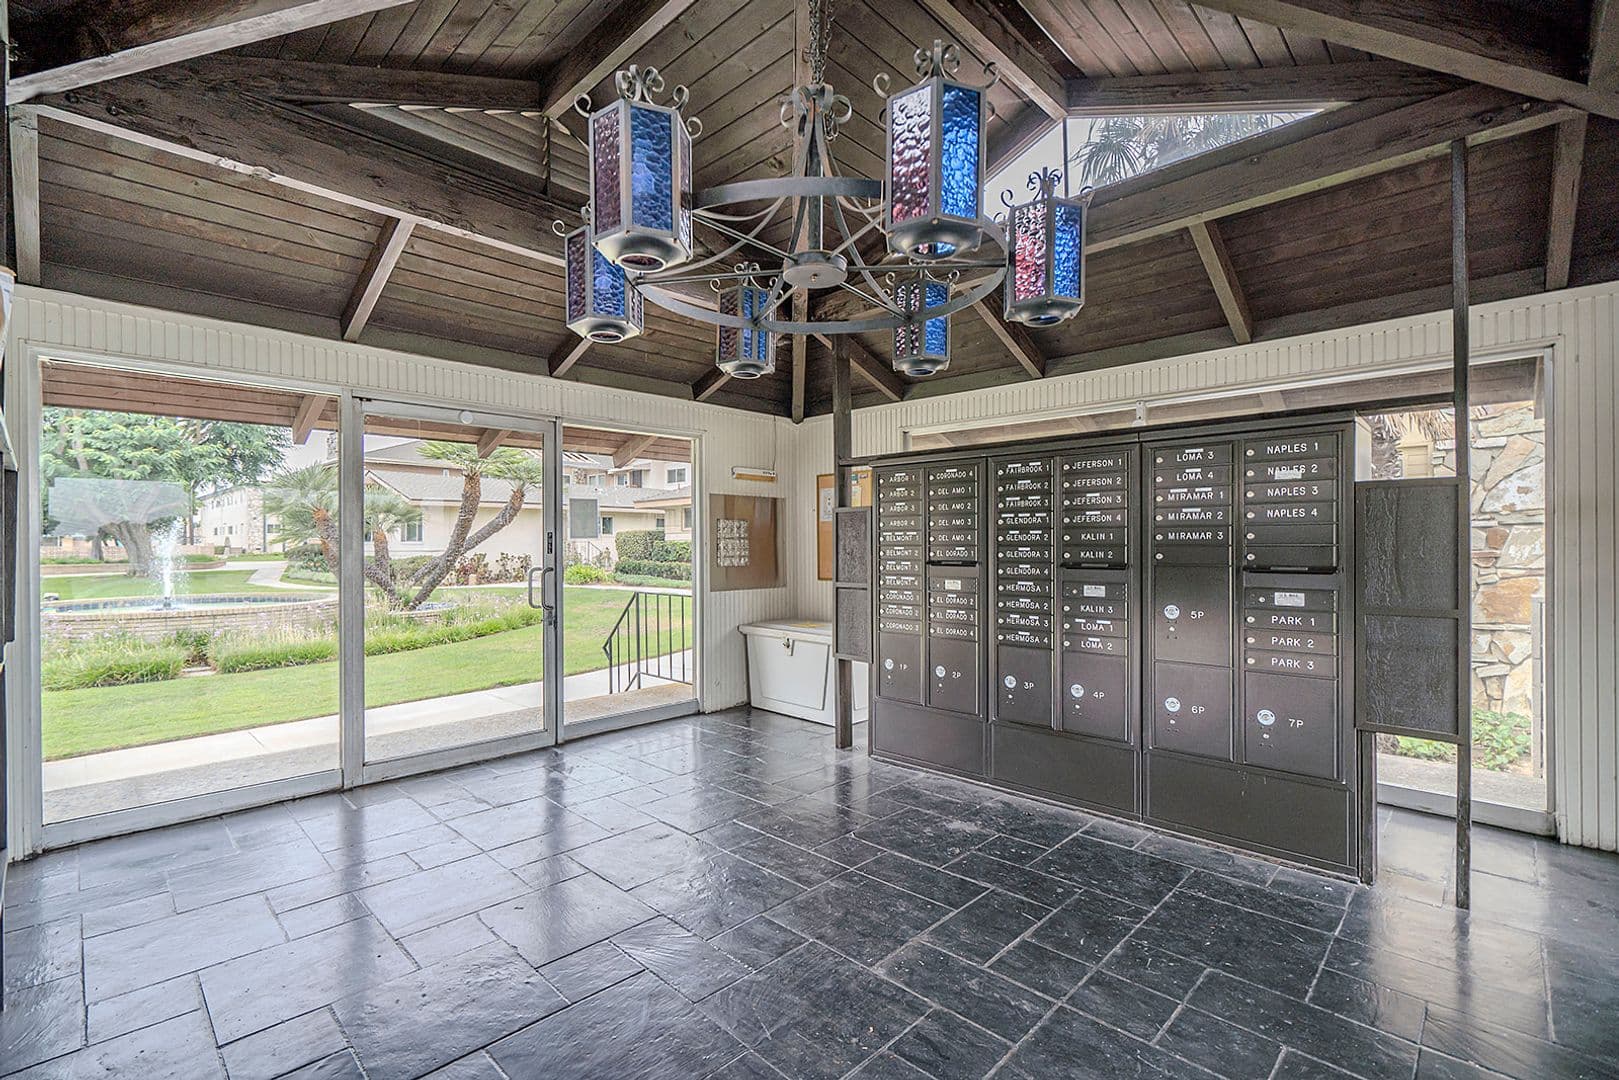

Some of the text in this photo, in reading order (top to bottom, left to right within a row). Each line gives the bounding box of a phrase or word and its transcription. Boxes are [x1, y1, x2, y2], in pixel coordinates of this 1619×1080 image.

[1267, 442, 1318, 454] NAPLES 1
[1176, 451, 1214, 462] LOMA 3
[1072, 459, 1113, 470] JEFERSON
[1311, 464, 1318, 473] 2
[1006, 466, 1042, 474] FAIRBROOK
[936, 471, 966, 480] CORONADO
[1176, 471, 1213, 481] LOMA 4
[1006, 482, 1041, 491] FAIRBROOK
[1073, 477, 1122, 487] JEFERSON 2
[1267, 486, 1318, 496] NAPLES 3
[1072, 496, 1112, 505] JEFERSON
[1168, 491, 1223, 501] MIRAMAR 1
[1168, 511, 1223, 520] MIRAMAR 2
[1267, 508, 1318, 517] NAPLES 4
[1006, 517, 1042, 525] GLENDORA
[1072, 515, 1112, 523] JEFERSON
[1168, 532, 1224, 540] MIRAMAR 3
[1080, 551, 1113, 559] KALIN 2
[1006, 567, 1040, 575] GLENDORA
[1006, 584, 1041, 593] HERMOSA
[945, 597, 968, 605] DORADO
[1006, 601, 1049, 610] HERMOSA 2
[1080, 605, 1113, 614] KALIN 3
[945, 612, 968, 620] DORADO
[1190, 611, 1205, 619] 5P
[1006, 617, 1049, 627] HERMOSA 3
[1271, 616, 1315, 626] PARK 1
[1081, 623, 1105, 631] LOMA
[945, 628, 968, 636] DORADO
[969, 629, 974, 637] 4
[1006, 634, 1048, 644] HERMOSA 4
[1271, 637, 1314, 648] PARK 2
[1080, 641, 1103, 649] LOMA
[1271, 658, 1314, 670] PARK 3
[952, 671, 961, 679] 2P
[1023, 682, 1034, 690] 3P
[1191, 705, 1205, 714] 6P
[1288, 718, 1304, 729] 7P
